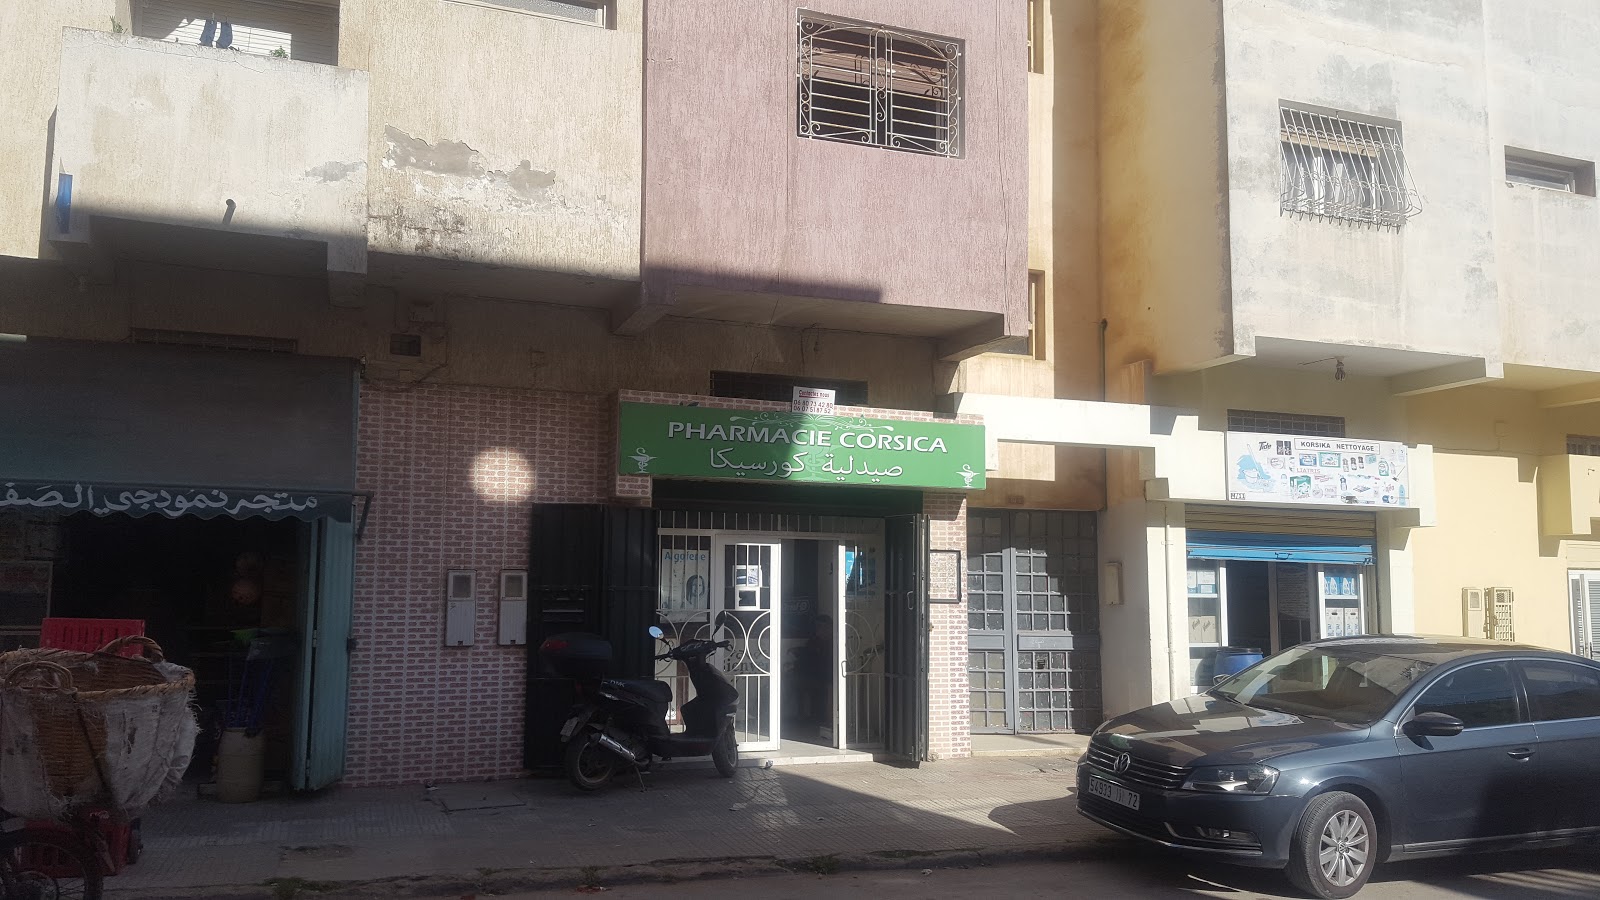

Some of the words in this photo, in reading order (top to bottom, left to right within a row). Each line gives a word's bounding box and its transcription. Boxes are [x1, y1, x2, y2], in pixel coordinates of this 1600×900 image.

[668, 422, 832, 448] PHARMACIE
[839, 431, 948, 454] CORSICA
[1258, 441, 1272, 451] Tide
[1300, 441, 1331, 450] KORSIKA
[1335, 443, 1375, 452] NETTOYAGE
[710, 447, 808, 479] كورسيكا
[821, 452, 903, 482] صيدلية
[223, 491, 318, 515] متجر
[1090, 778, 1112, 798] 54933
[1128, 792, 1138, 808] 72
